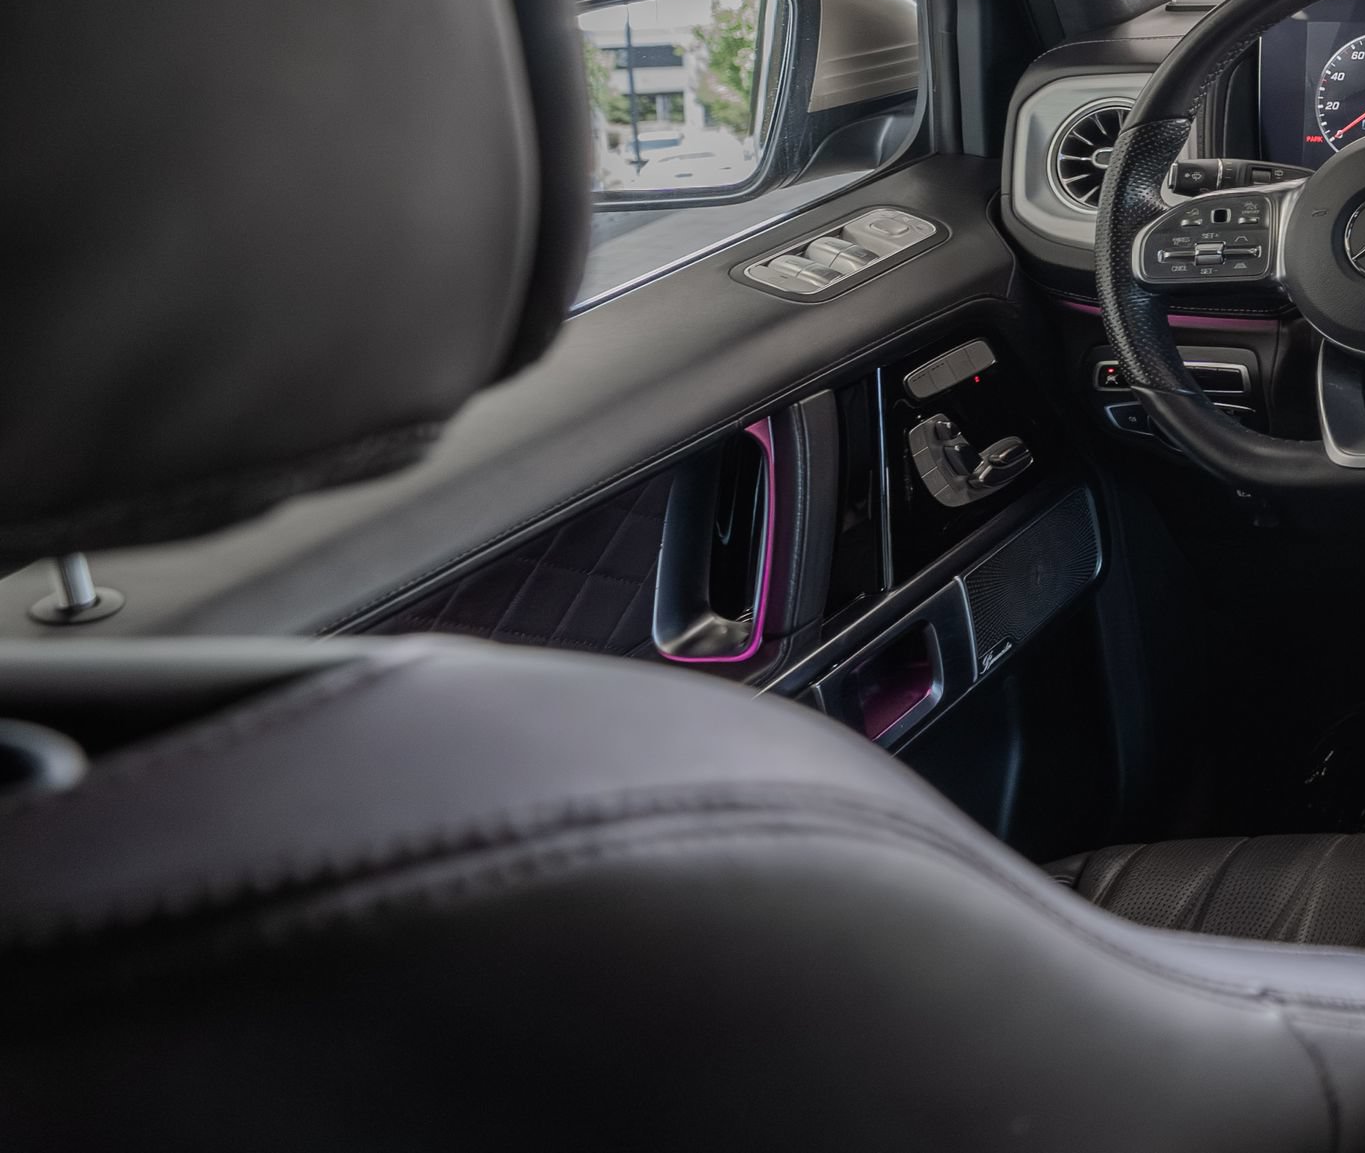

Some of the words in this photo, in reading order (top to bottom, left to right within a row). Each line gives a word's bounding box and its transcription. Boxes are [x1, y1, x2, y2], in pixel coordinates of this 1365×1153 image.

[1351, 51, 1365, 60] 60
[1330, 72, 1345, 81] 40
[1325, 102, 1339, 110] 20
